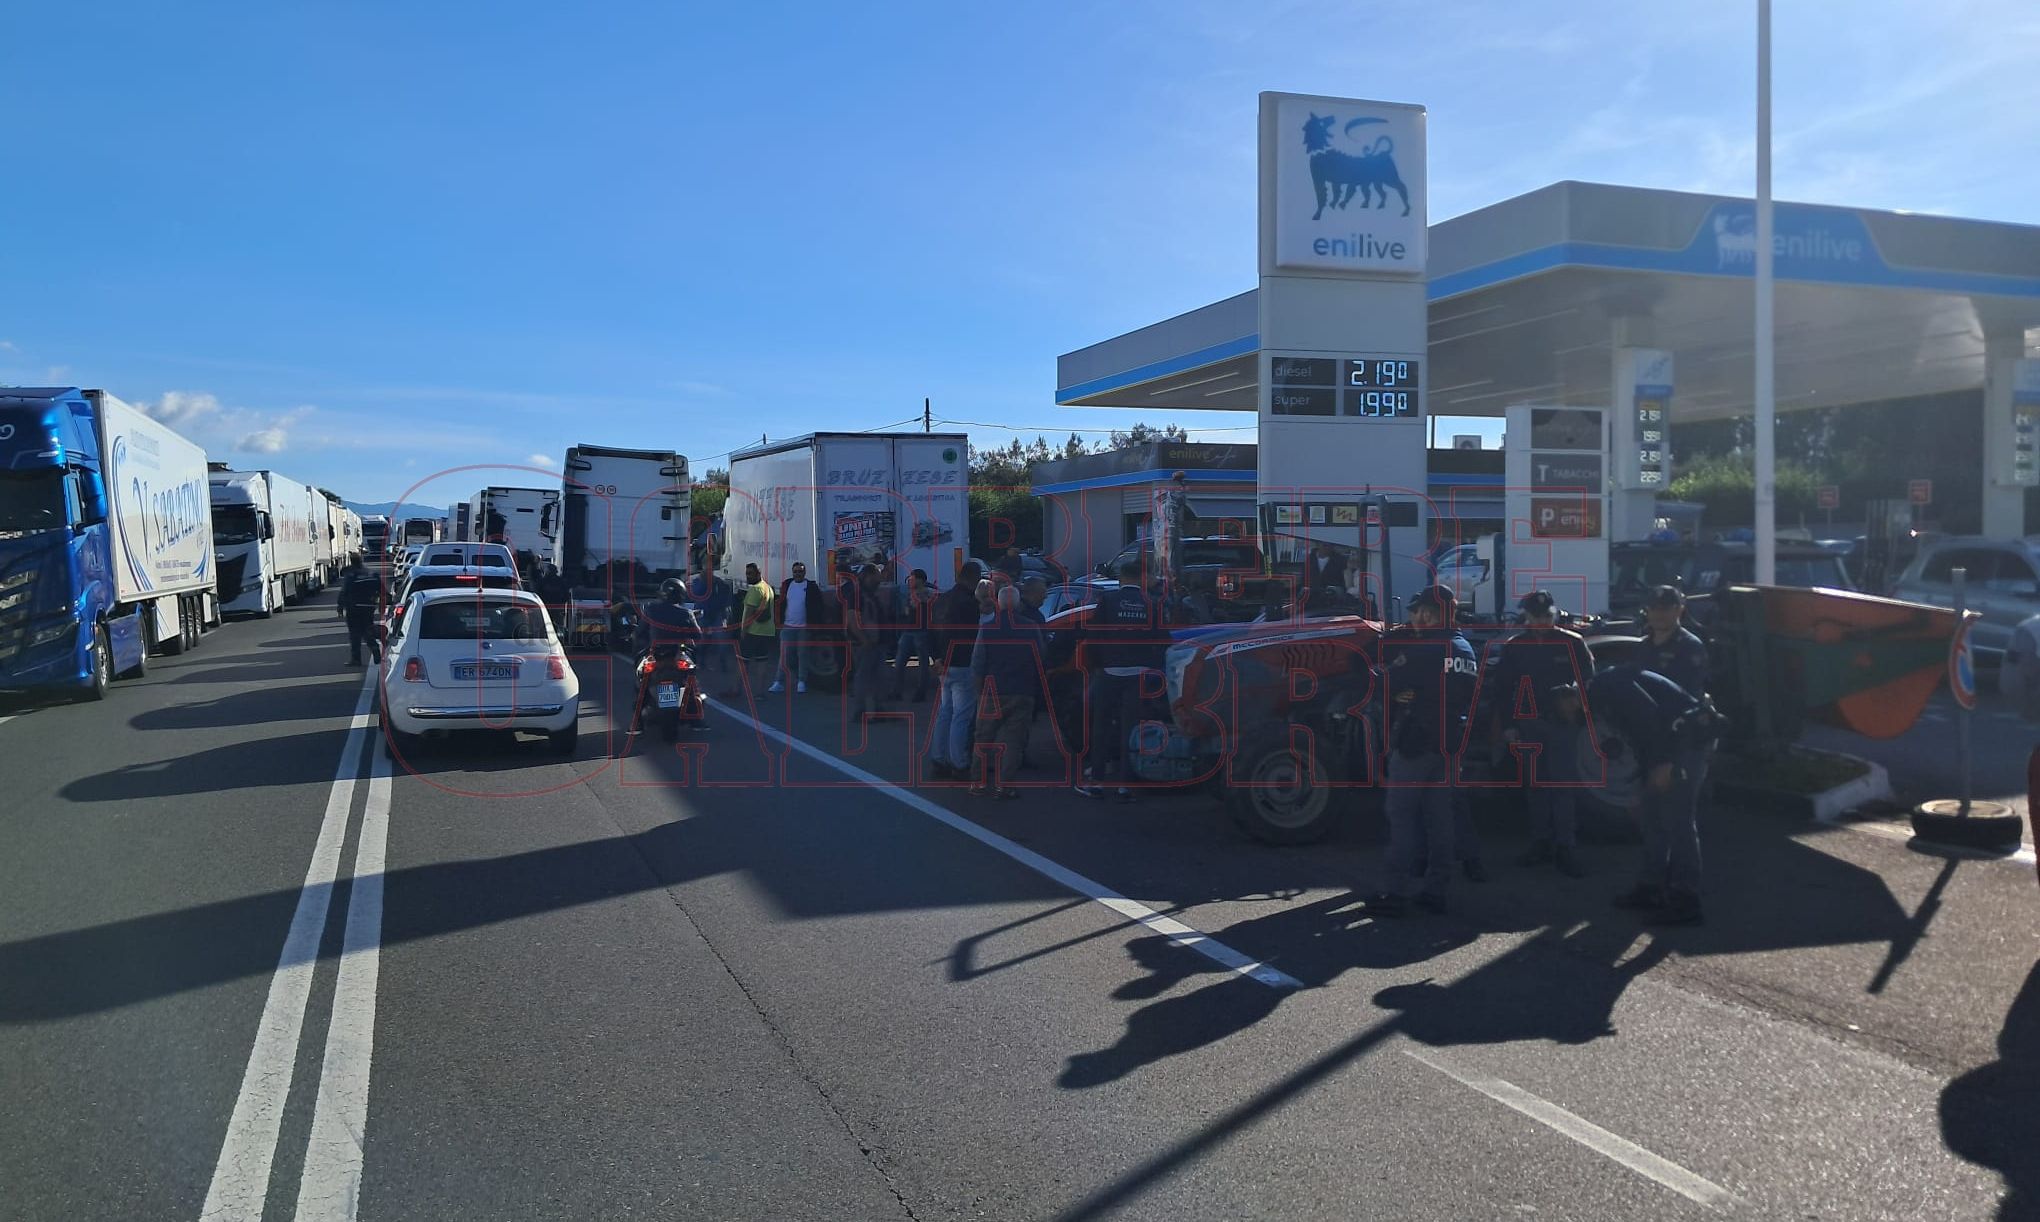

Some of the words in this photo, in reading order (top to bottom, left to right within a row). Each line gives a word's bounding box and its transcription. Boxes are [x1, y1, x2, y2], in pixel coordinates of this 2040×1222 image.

[1312, 232, 1405, 261] enilive
[1771, 227, 1863, 262] enilive
[1274, 362, 1312, 377] diesel
[1274, 394, 1310, 408] super
[1552, 468, 1600, 480] TABACCHI
[1541, 507, 1555, 528] P
